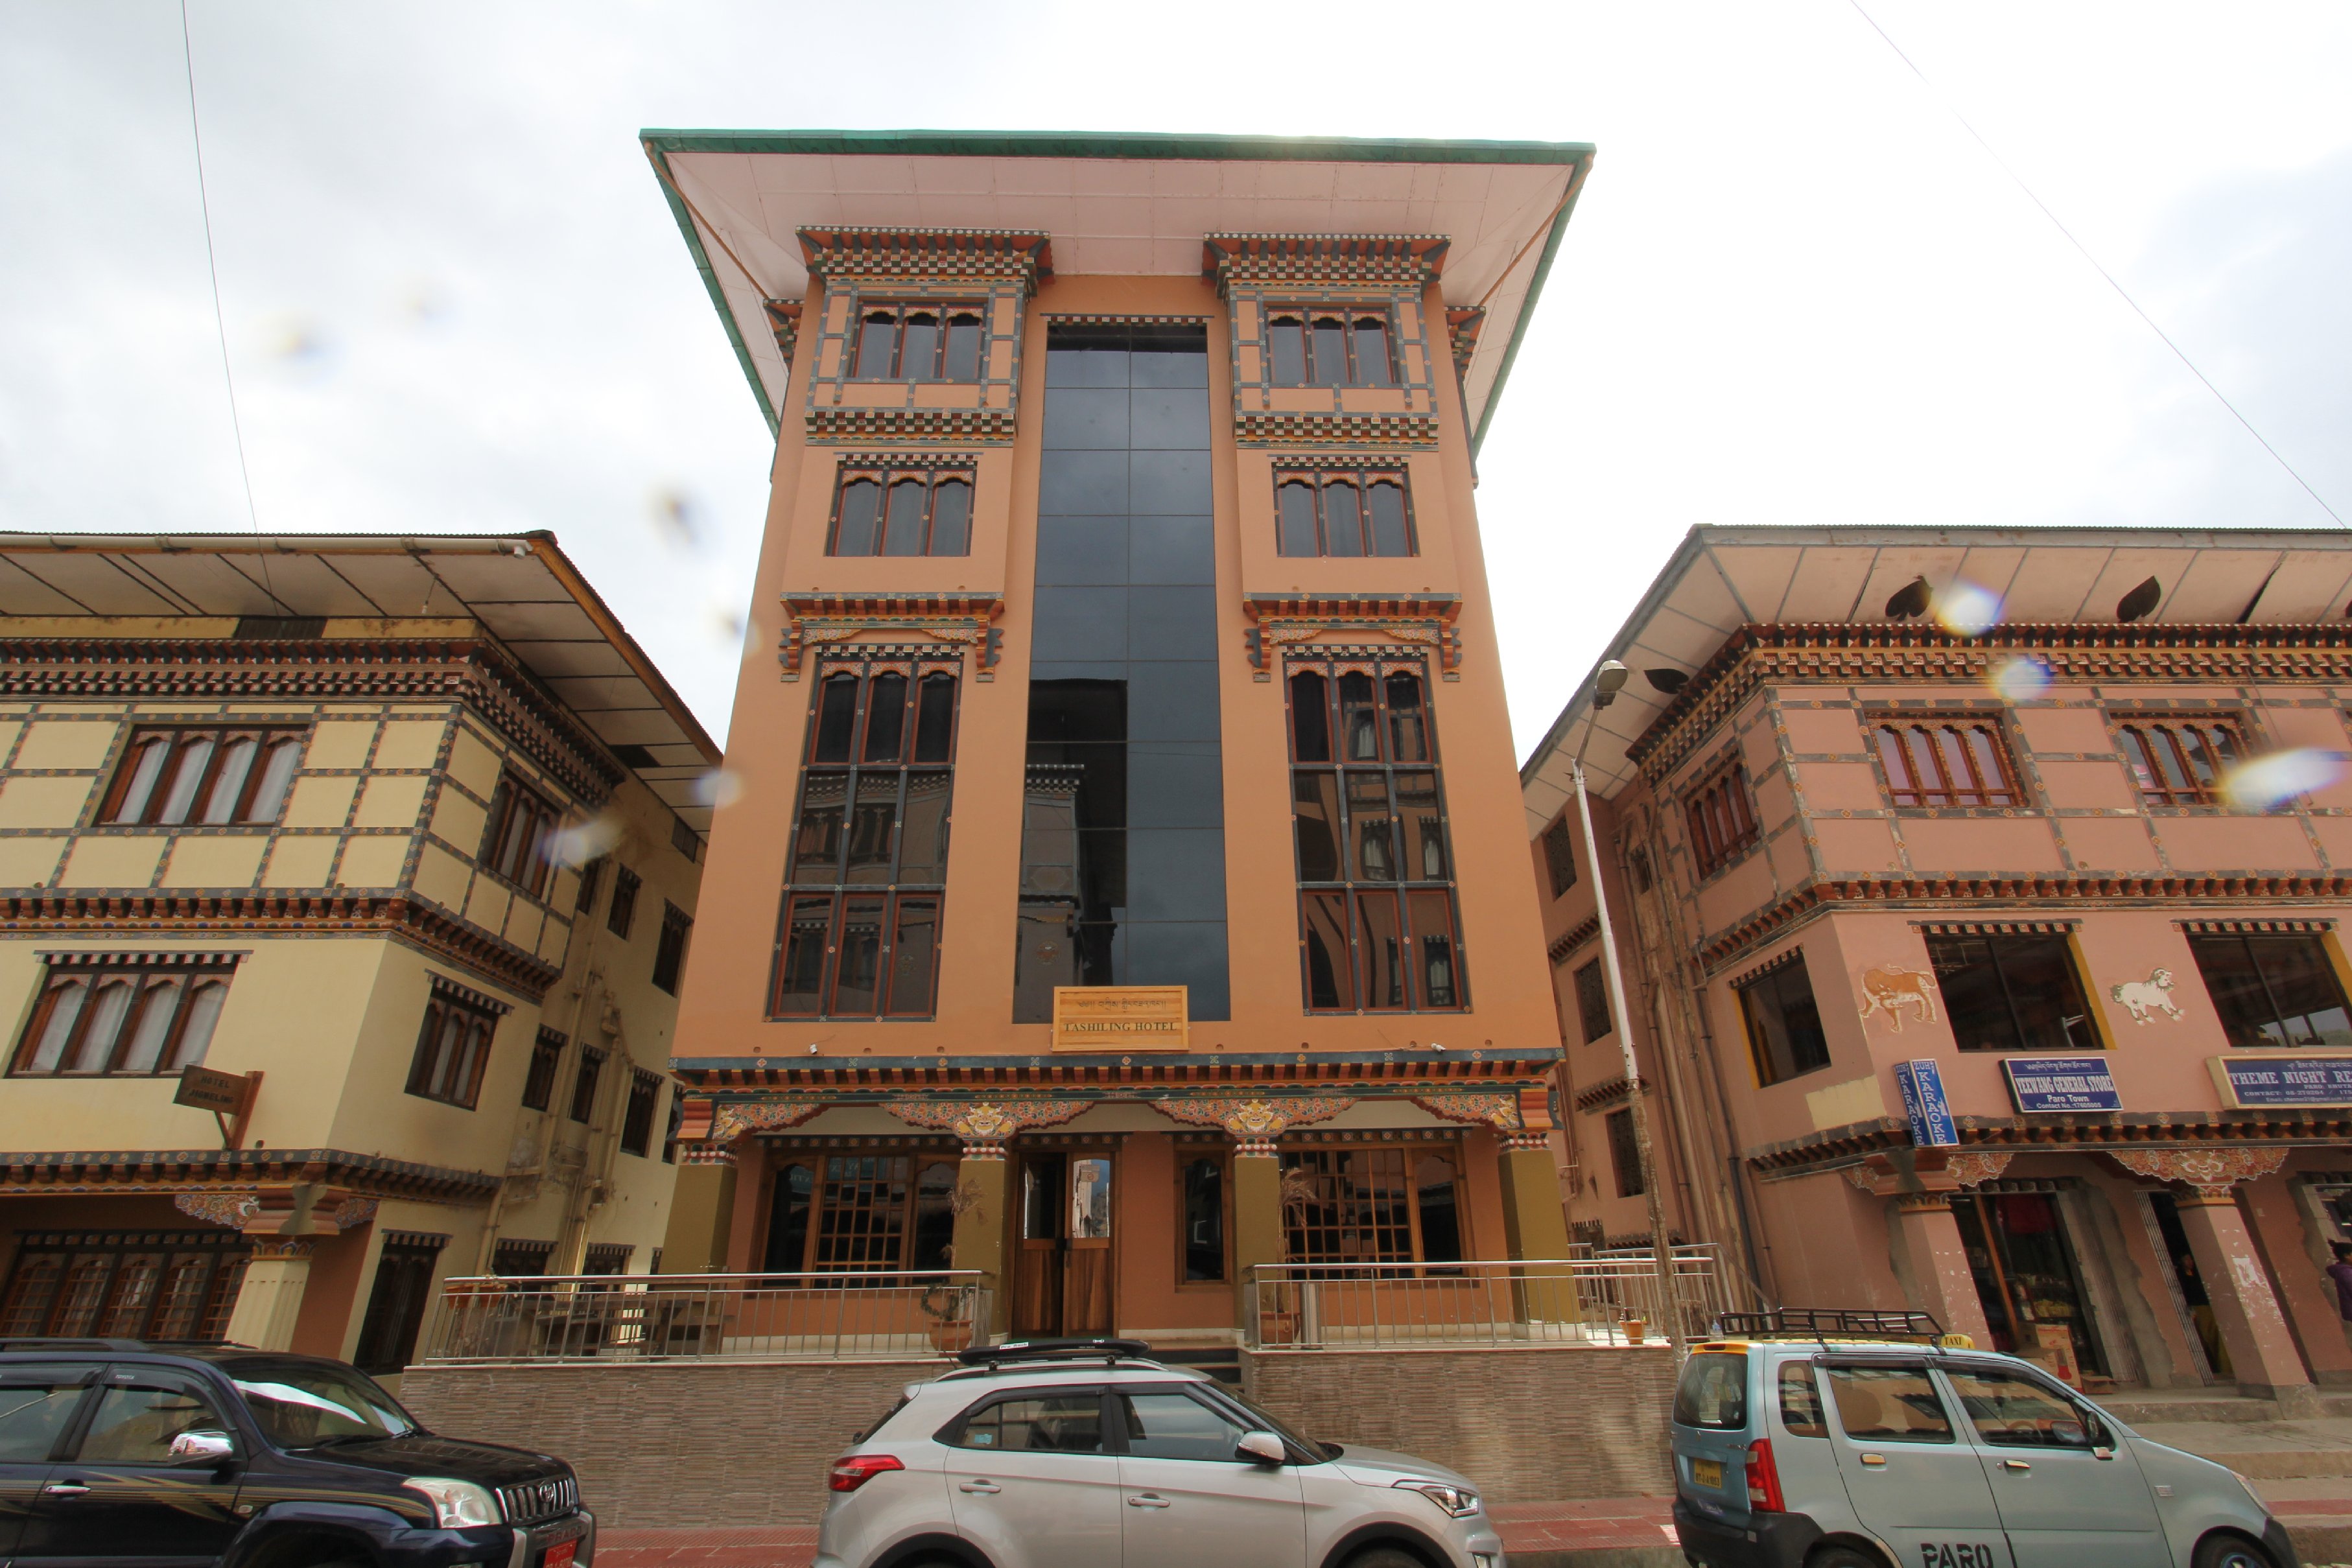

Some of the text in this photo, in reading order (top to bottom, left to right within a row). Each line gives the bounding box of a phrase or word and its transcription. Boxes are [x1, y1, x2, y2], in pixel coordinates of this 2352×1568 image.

[1064, 1022, 1177, 1032] TASHILING HOTEL
[200, 1075, 229, 1088] HOTEL
[2015, 1075, 2115, 1094] YEEWANG GENERAL STORE
[2229, 1070, 2352, 1084] THEME NIGHT RE
[1899, 1074, 1925, 1145] KARAOKE
[1918, 1071, 1947, 1143] KARAOKE
[1945, 1337, 1962, 1345] TAXI
[547, 1525, 582, 1541] PRADO
[1920, 1543, 1993, 1568] PARO
